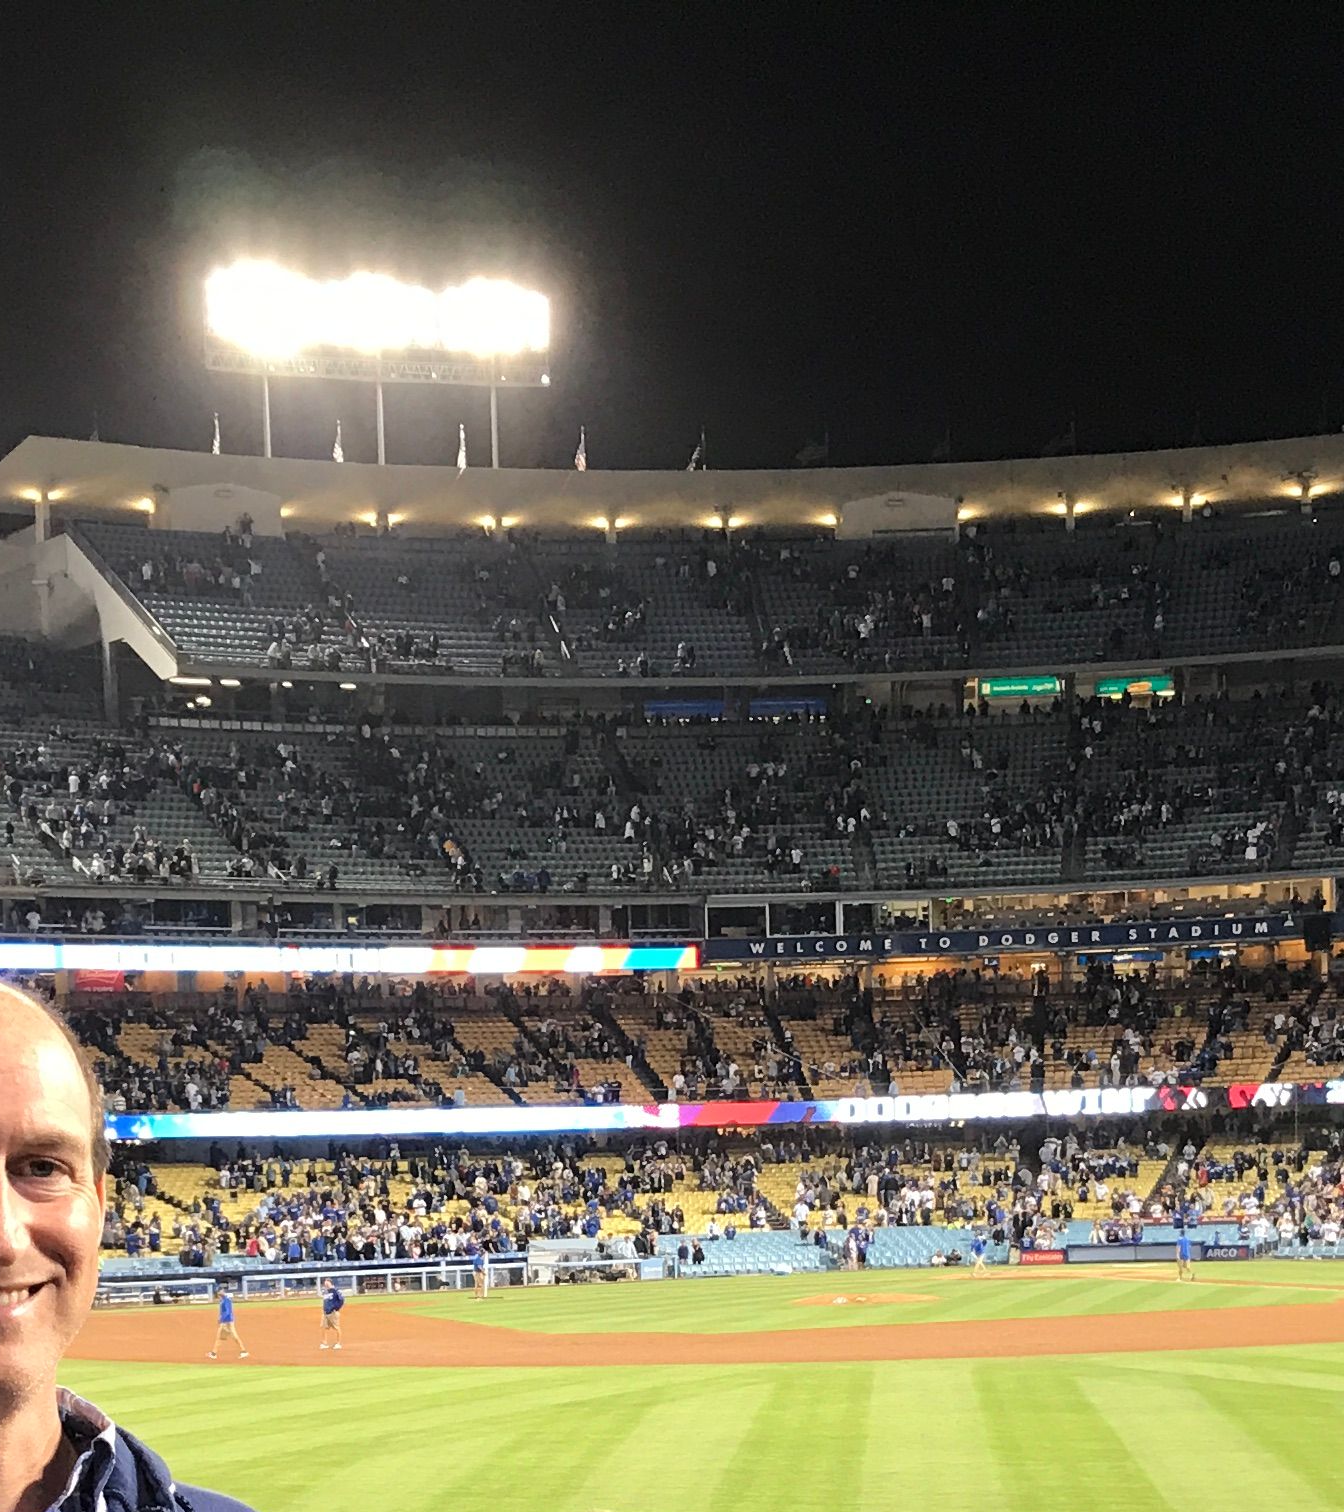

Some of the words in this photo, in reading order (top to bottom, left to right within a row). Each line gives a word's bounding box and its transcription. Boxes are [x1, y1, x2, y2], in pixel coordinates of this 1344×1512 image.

[750, 938, 892, 954] WELCOME
[919, 936, 951, 949] TO
[978, 929, 1101, 947] DODGER
[1128, 921, 1269, 941] STADIUM
[1207, 1247, 1237, 1258] ARCO
